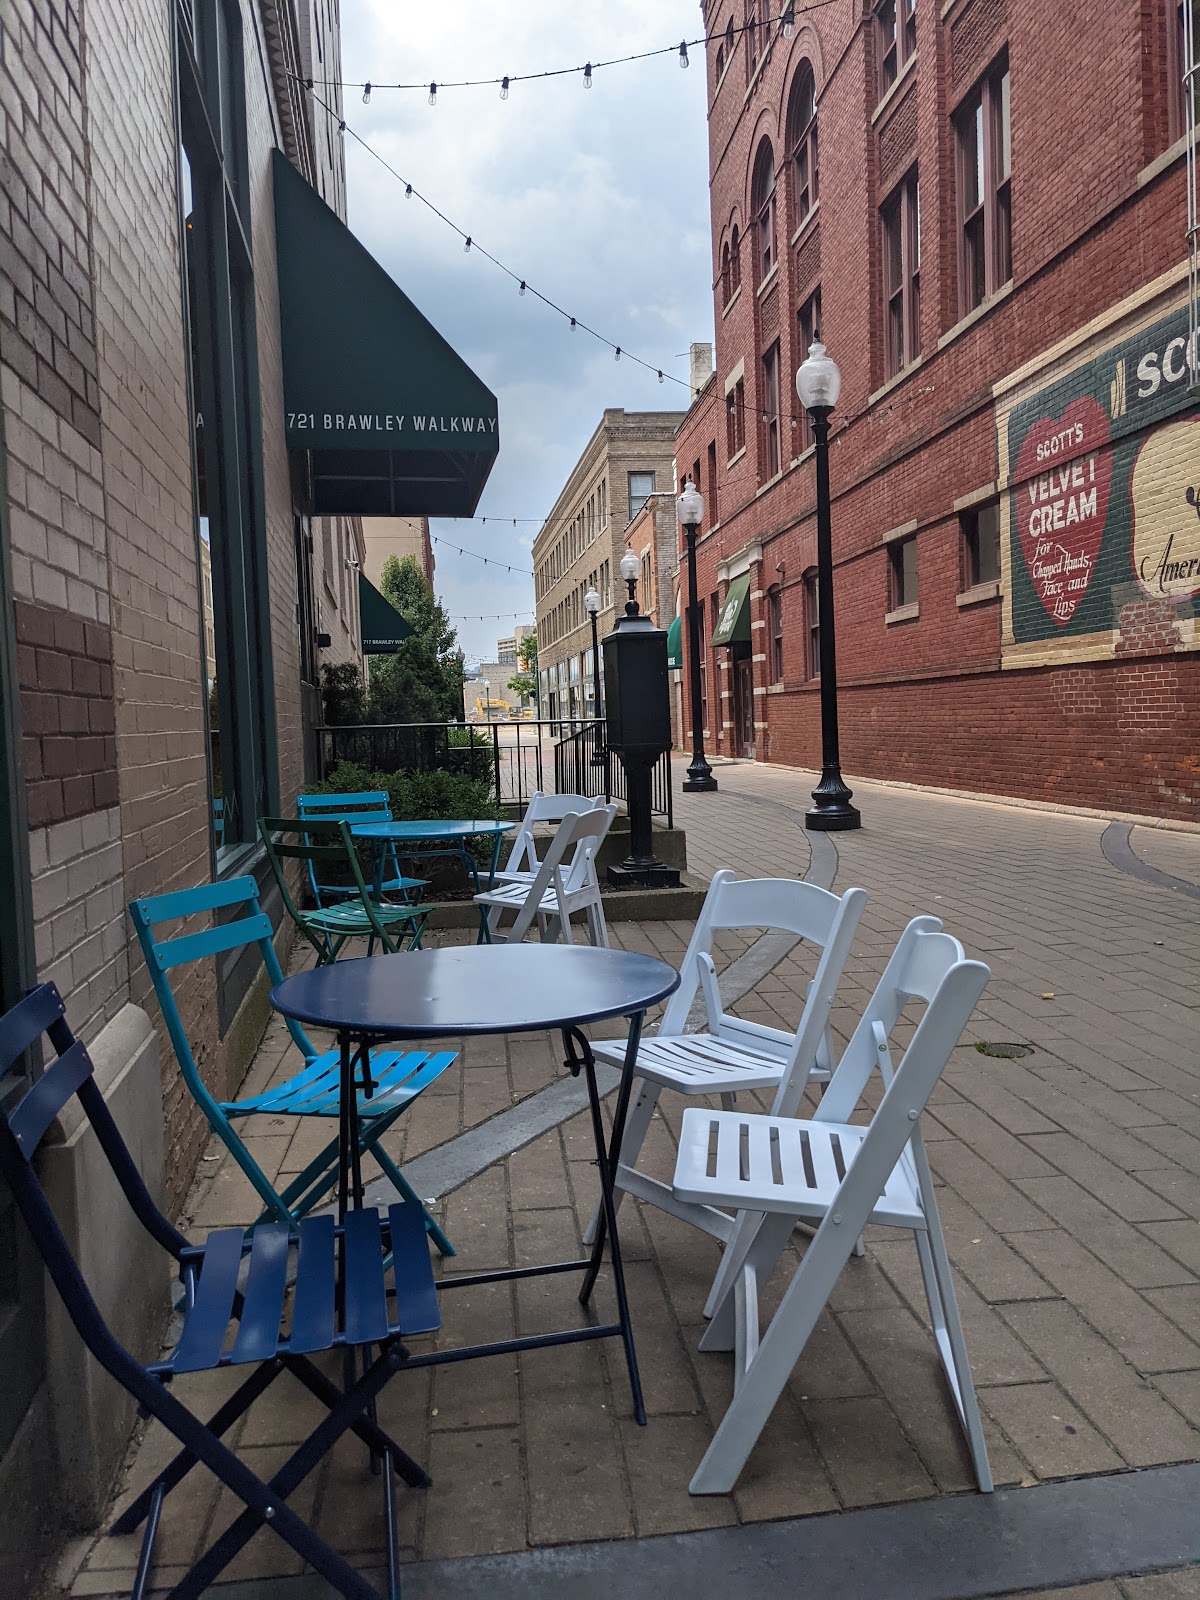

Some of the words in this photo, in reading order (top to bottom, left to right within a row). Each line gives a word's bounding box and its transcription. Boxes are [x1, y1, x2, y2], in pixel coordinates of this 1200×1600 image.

[287, 413, 315, 429] 721
[323, 414, 405, 431] BRAWLEY
[413, 415, 497, 433] WALKWAY
[1036, 422, 1084, 461] SCOTT'S
[1027, 449, 1099, 505] VELVET
[1028, 486, 1097, 538] CREAM
[1028, 537, 1053, 564] for
[1032, 556, 1063, 579] Chapped
[1067, 569, 1090, 591] and
[1053, 596, 1077, 620] Lips
